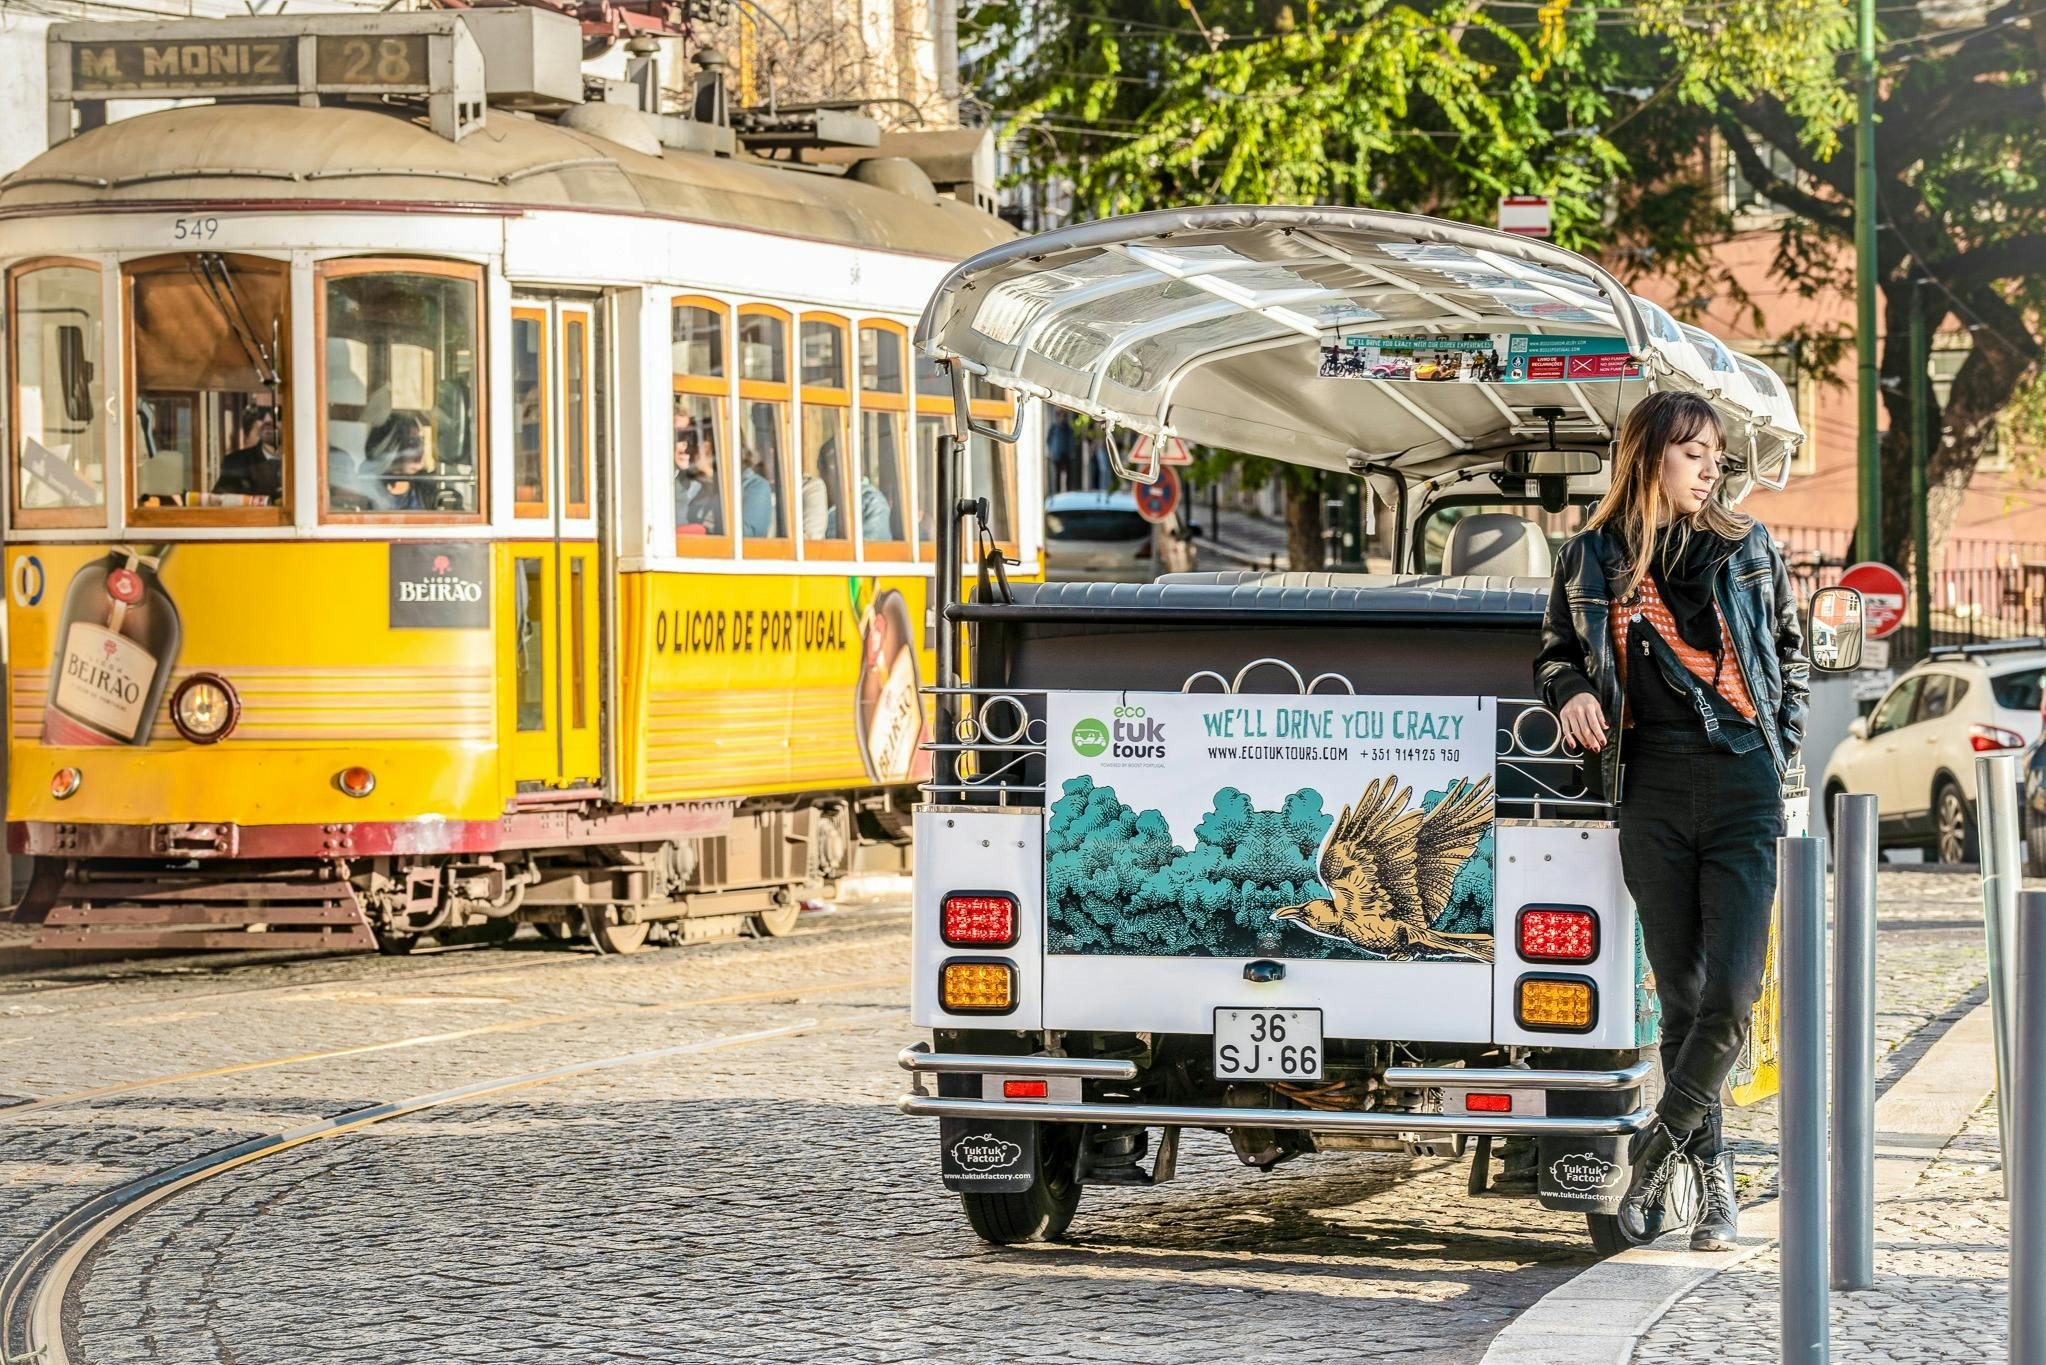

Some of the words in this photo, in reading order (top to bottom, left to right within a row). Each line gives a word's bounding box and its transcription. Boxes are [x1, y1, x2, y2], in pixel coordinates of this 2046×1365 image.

[144, 45, 281, 77] MONIZ
[343, 39, 410, 83] 28
[174, 217, 219, 240] 549
[399, 580, 482, 602] BEIRÃO
[656, 610, 667, 652] O
[674, 610, 726, 652] LICOR
[732, 610, 754, 651] DE
[760, 610, 846, 651] PORTUGAL
[67, 652, 139, 705] BEIRÃO
[1113, 706, 1146, 718] eco
[1203, 709, 1267, 738] WE'LL
[1276, 708, 1334, 739] DRIVE
[1341, 710, 1384, 739] YOU
[1392, 710, 1464, 741] CRAZY
[1113, 717, 1166, 742] tuk
[1113, 742, 1166, 758] tours
[1208, 746, 1348, 761] WWW.ECOTUKTOURS.COM
[1442, 749, 1460, 762] 950
[1250, 1013, 1286, 1042] 36
